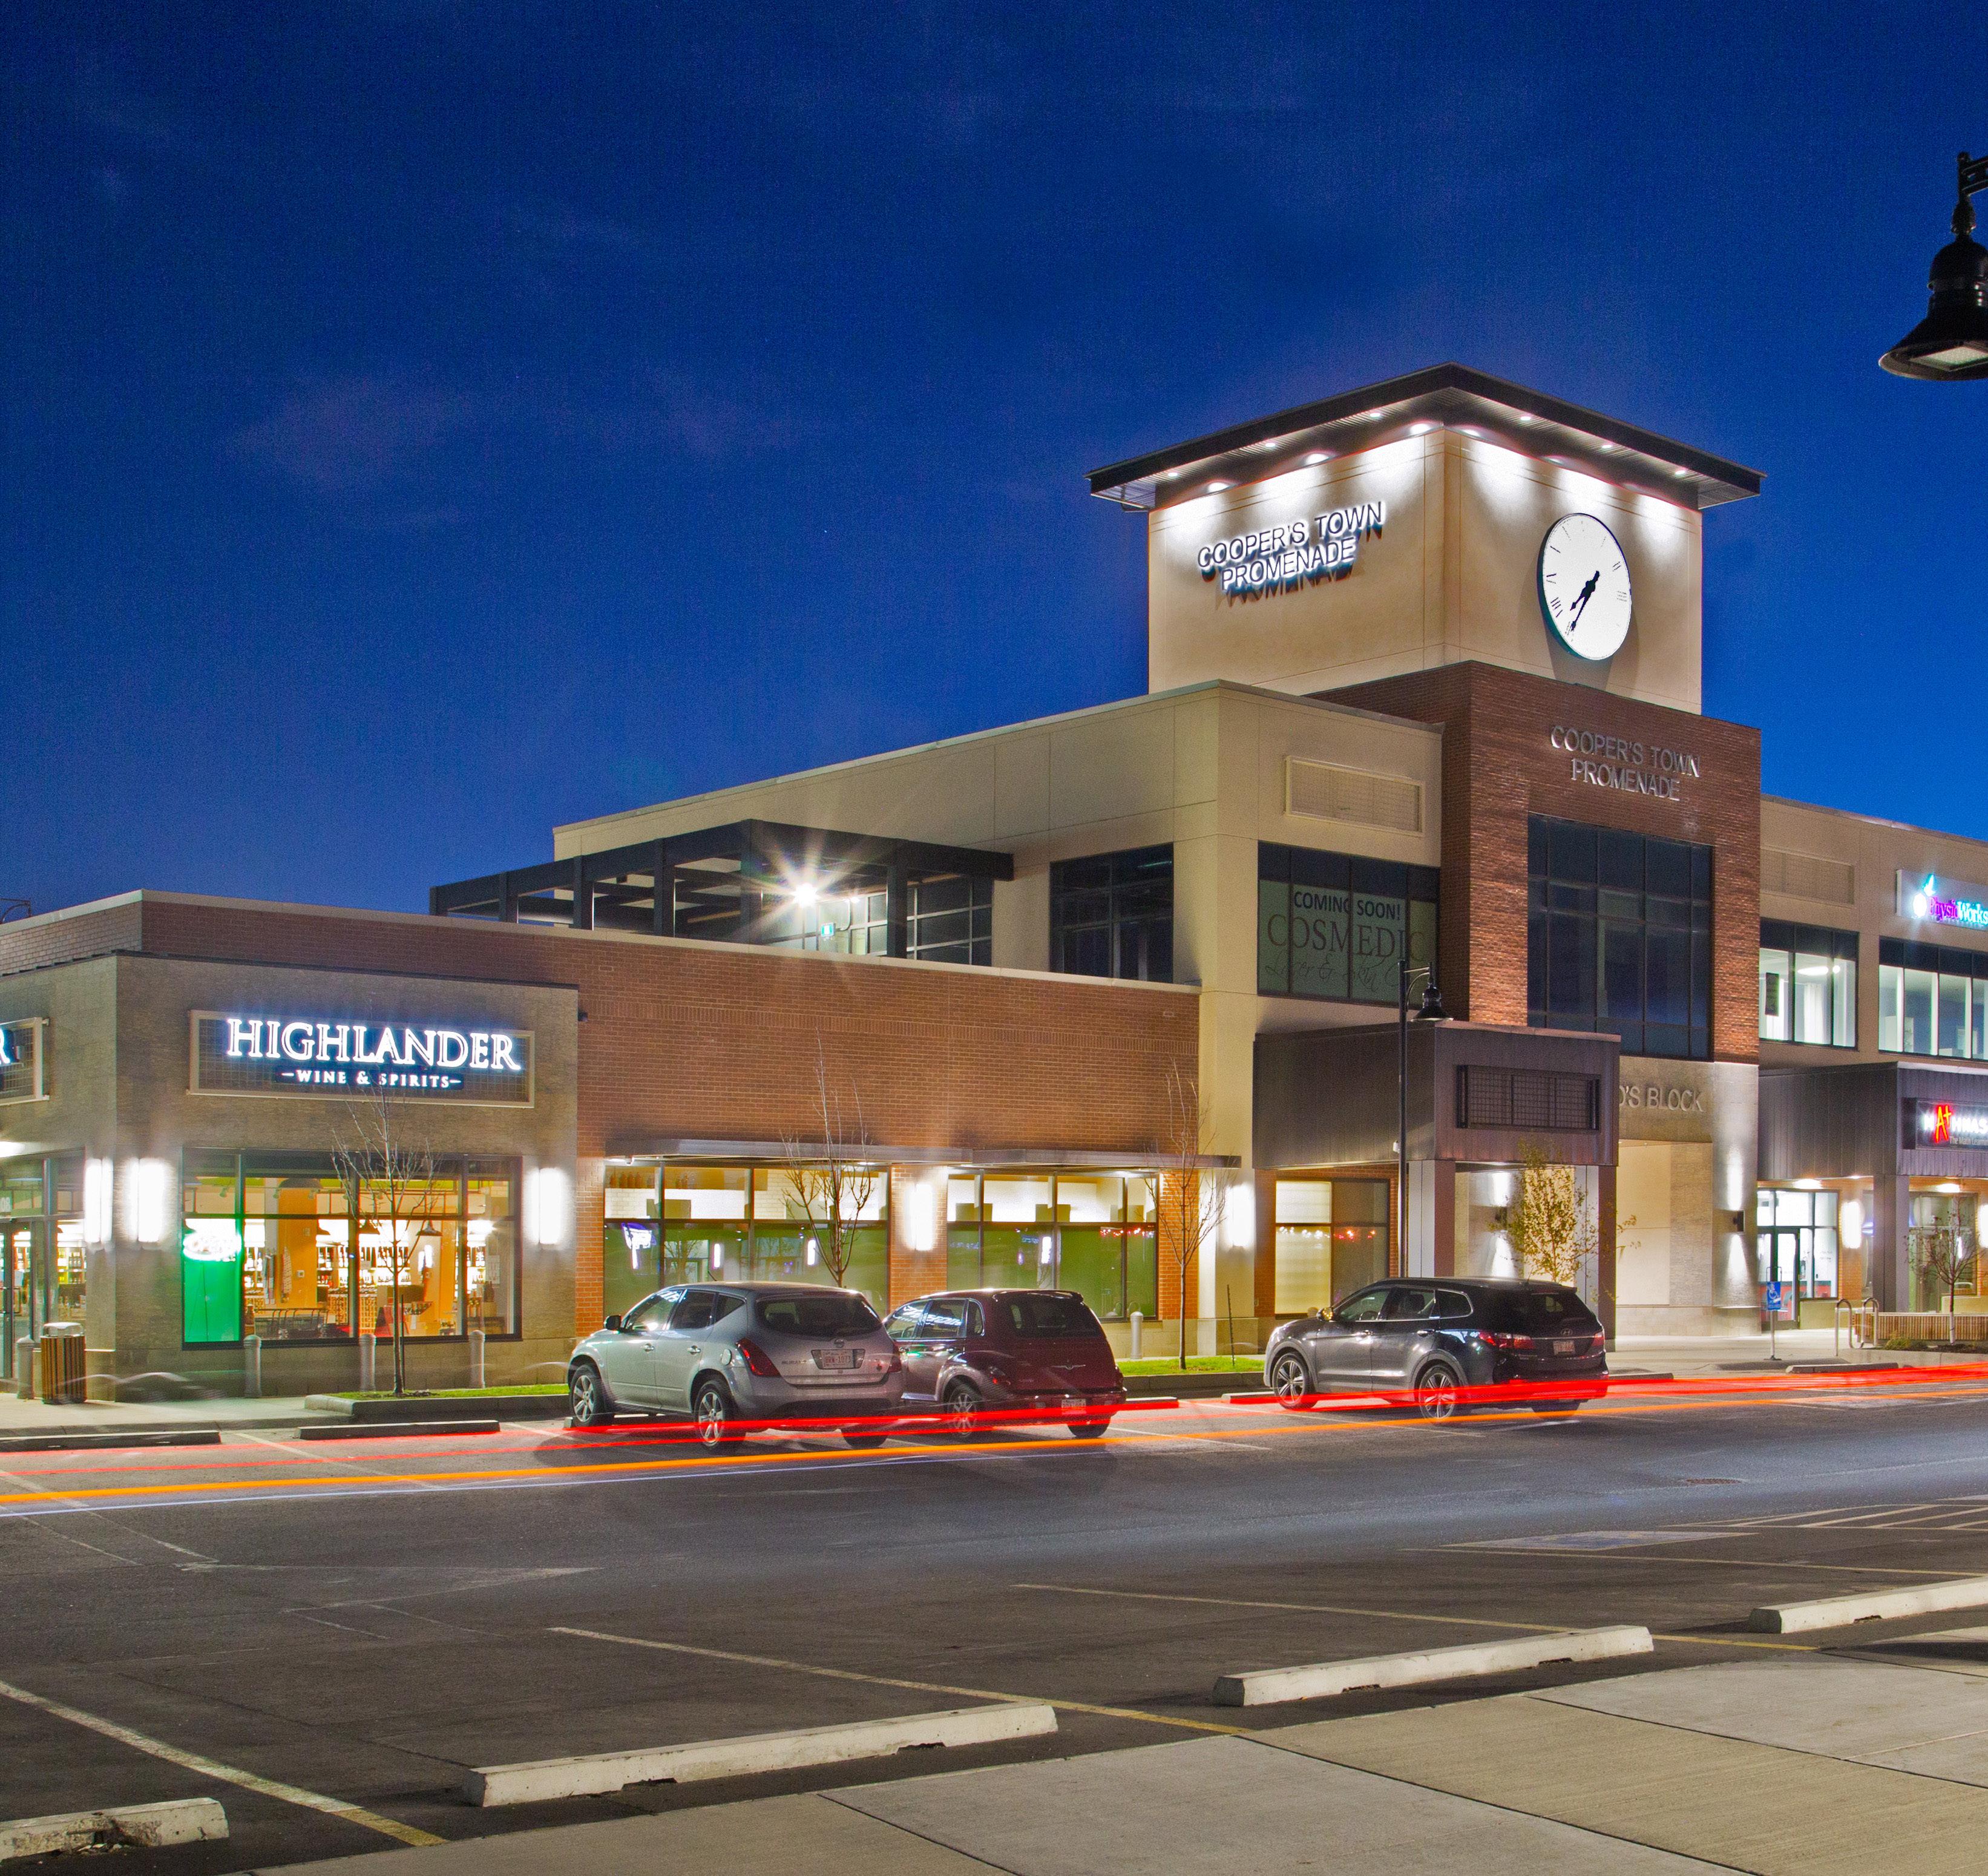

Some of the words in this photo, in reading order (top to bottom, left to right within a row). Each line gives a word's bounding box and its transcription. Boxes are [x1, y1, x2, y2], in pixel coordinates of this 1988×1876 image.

[1197, 521, 1305, 568] COOPER'S
[1314, 501, 1382, 537] TOWN
[1221, 536, 1356, 591] PROMENADE
[1551, 726, 1644, 765] COOPER'S
[1651, 745, 1700, 778] TOWN
[1571, 758, 1681, 801] PROMENADE
[1357, 900, 1400, 920] SOON!
[226, 1018, 521, 1070] HIGHLANDER
[295, 1069, 347, 1084] WINE
[356, 1071, 370, 1084] &
[379, 1073, 450, 1087] SPIRITS
[1647, 1087, 1705, 1112] BLOCK
